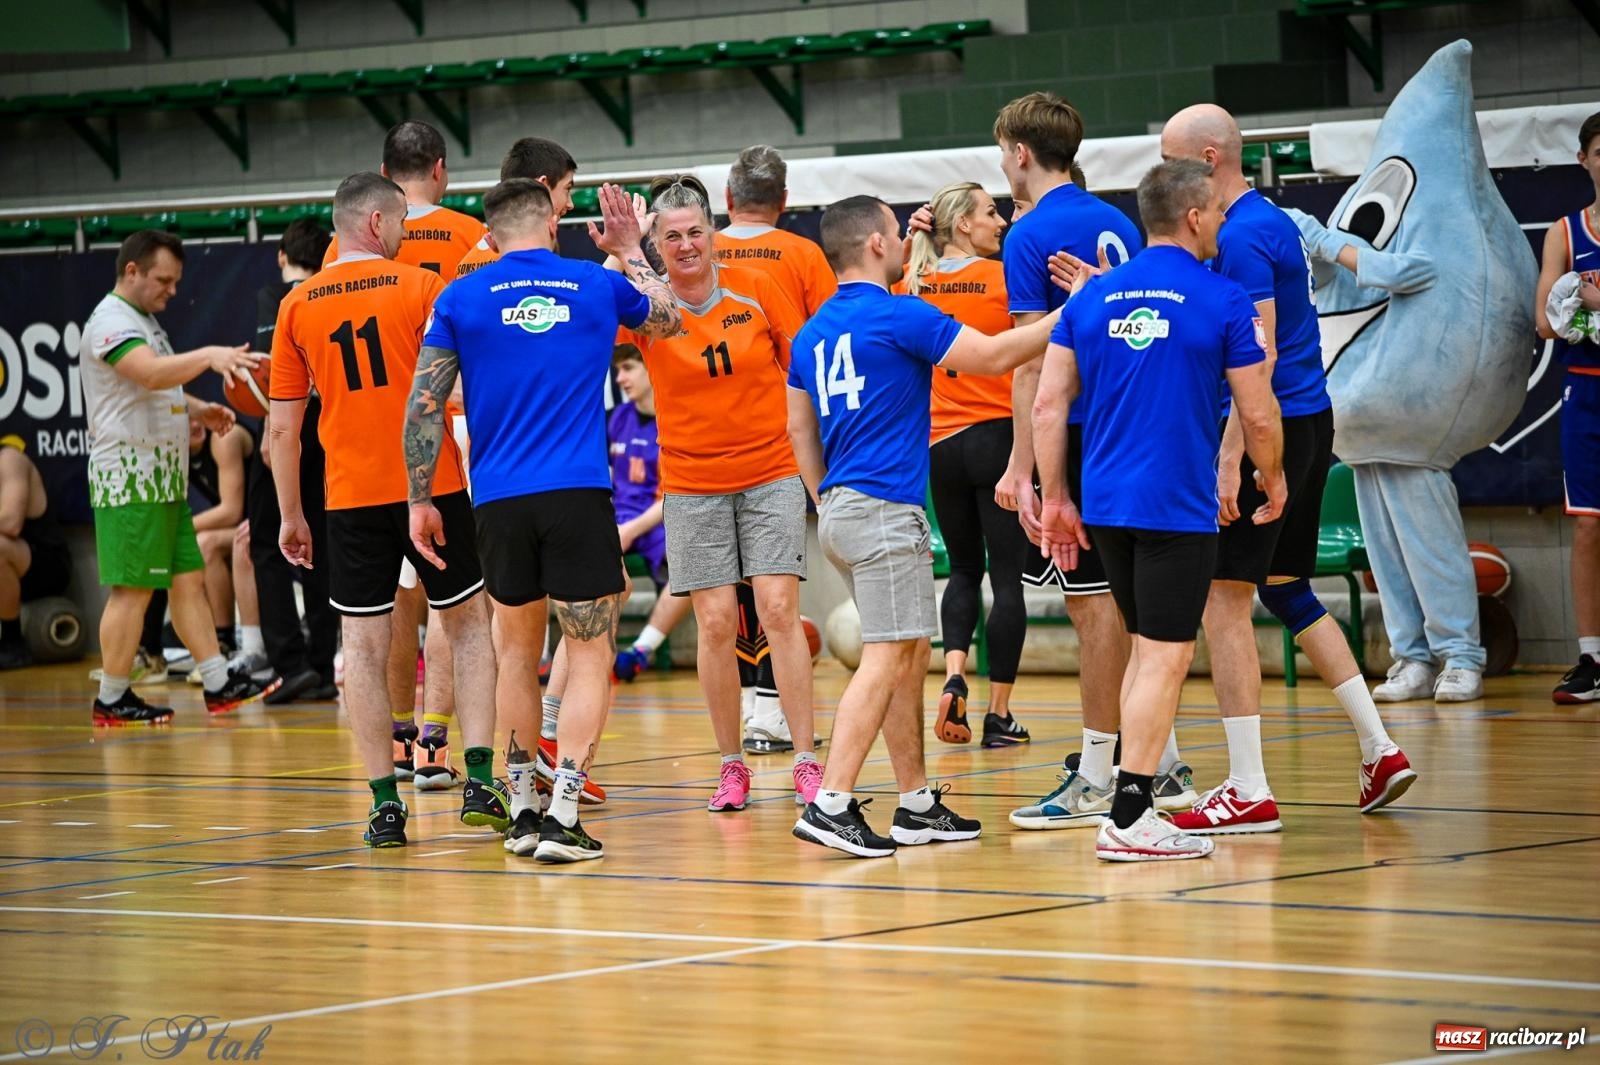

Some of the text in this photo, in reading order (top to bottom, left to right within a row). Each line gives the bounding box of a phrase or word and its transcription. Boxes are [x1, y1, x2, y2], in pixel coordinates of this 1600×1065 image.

[402, 228, 452, 241] ACIBÓRZ
[734, 247, 782, 261] RACIBÓRZ
[307, 273, 399, 302] ZSOMS RACIBÓRZ
[511, 279, 533, 289] UNIA
[533, 278, 580, 292] RACIBÓRZ
[939, 280, 987, 294] RACIBÓRZ
[1124, 289, 1144, 300] UNIA
[1144, 288, 1186, 304] RACIBÓRZ
[721, 309, 753, 330] ZSOMS
[328, 315, 389, 392] 11
[700, 340, 733, 379] 11
[813, 332, 866, 417] 14
